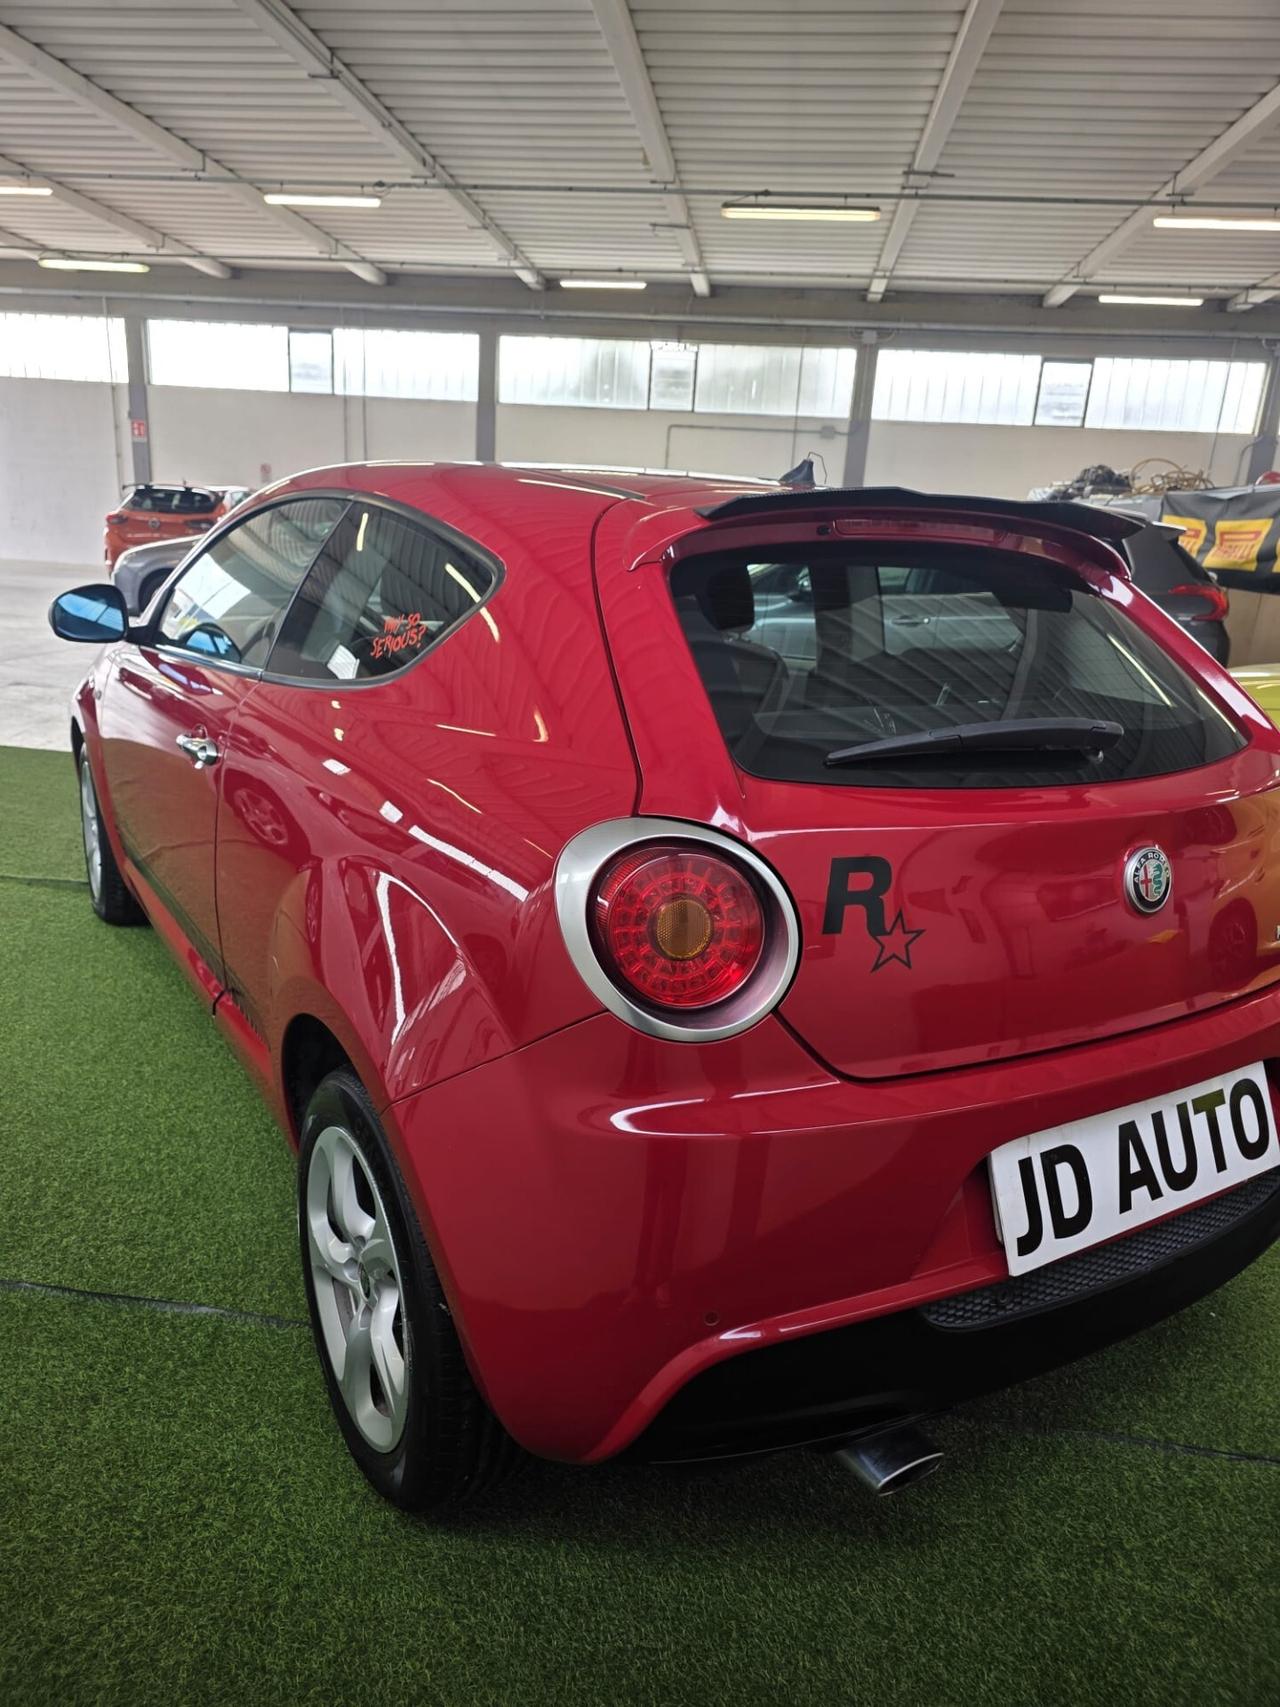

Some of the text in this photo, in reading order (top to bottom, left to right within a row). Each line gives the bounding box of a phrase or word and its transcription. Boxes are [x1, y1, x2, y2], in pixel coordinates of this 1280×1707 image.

[405, 612, 421, 630] SO
[370, 625, 427, 659] SERIOUS?
[1133, 858, 1146, 883] ALFA
[822, 856, 892, 936] R
[1016, 1078, 1270, 1257] JD AUTO
